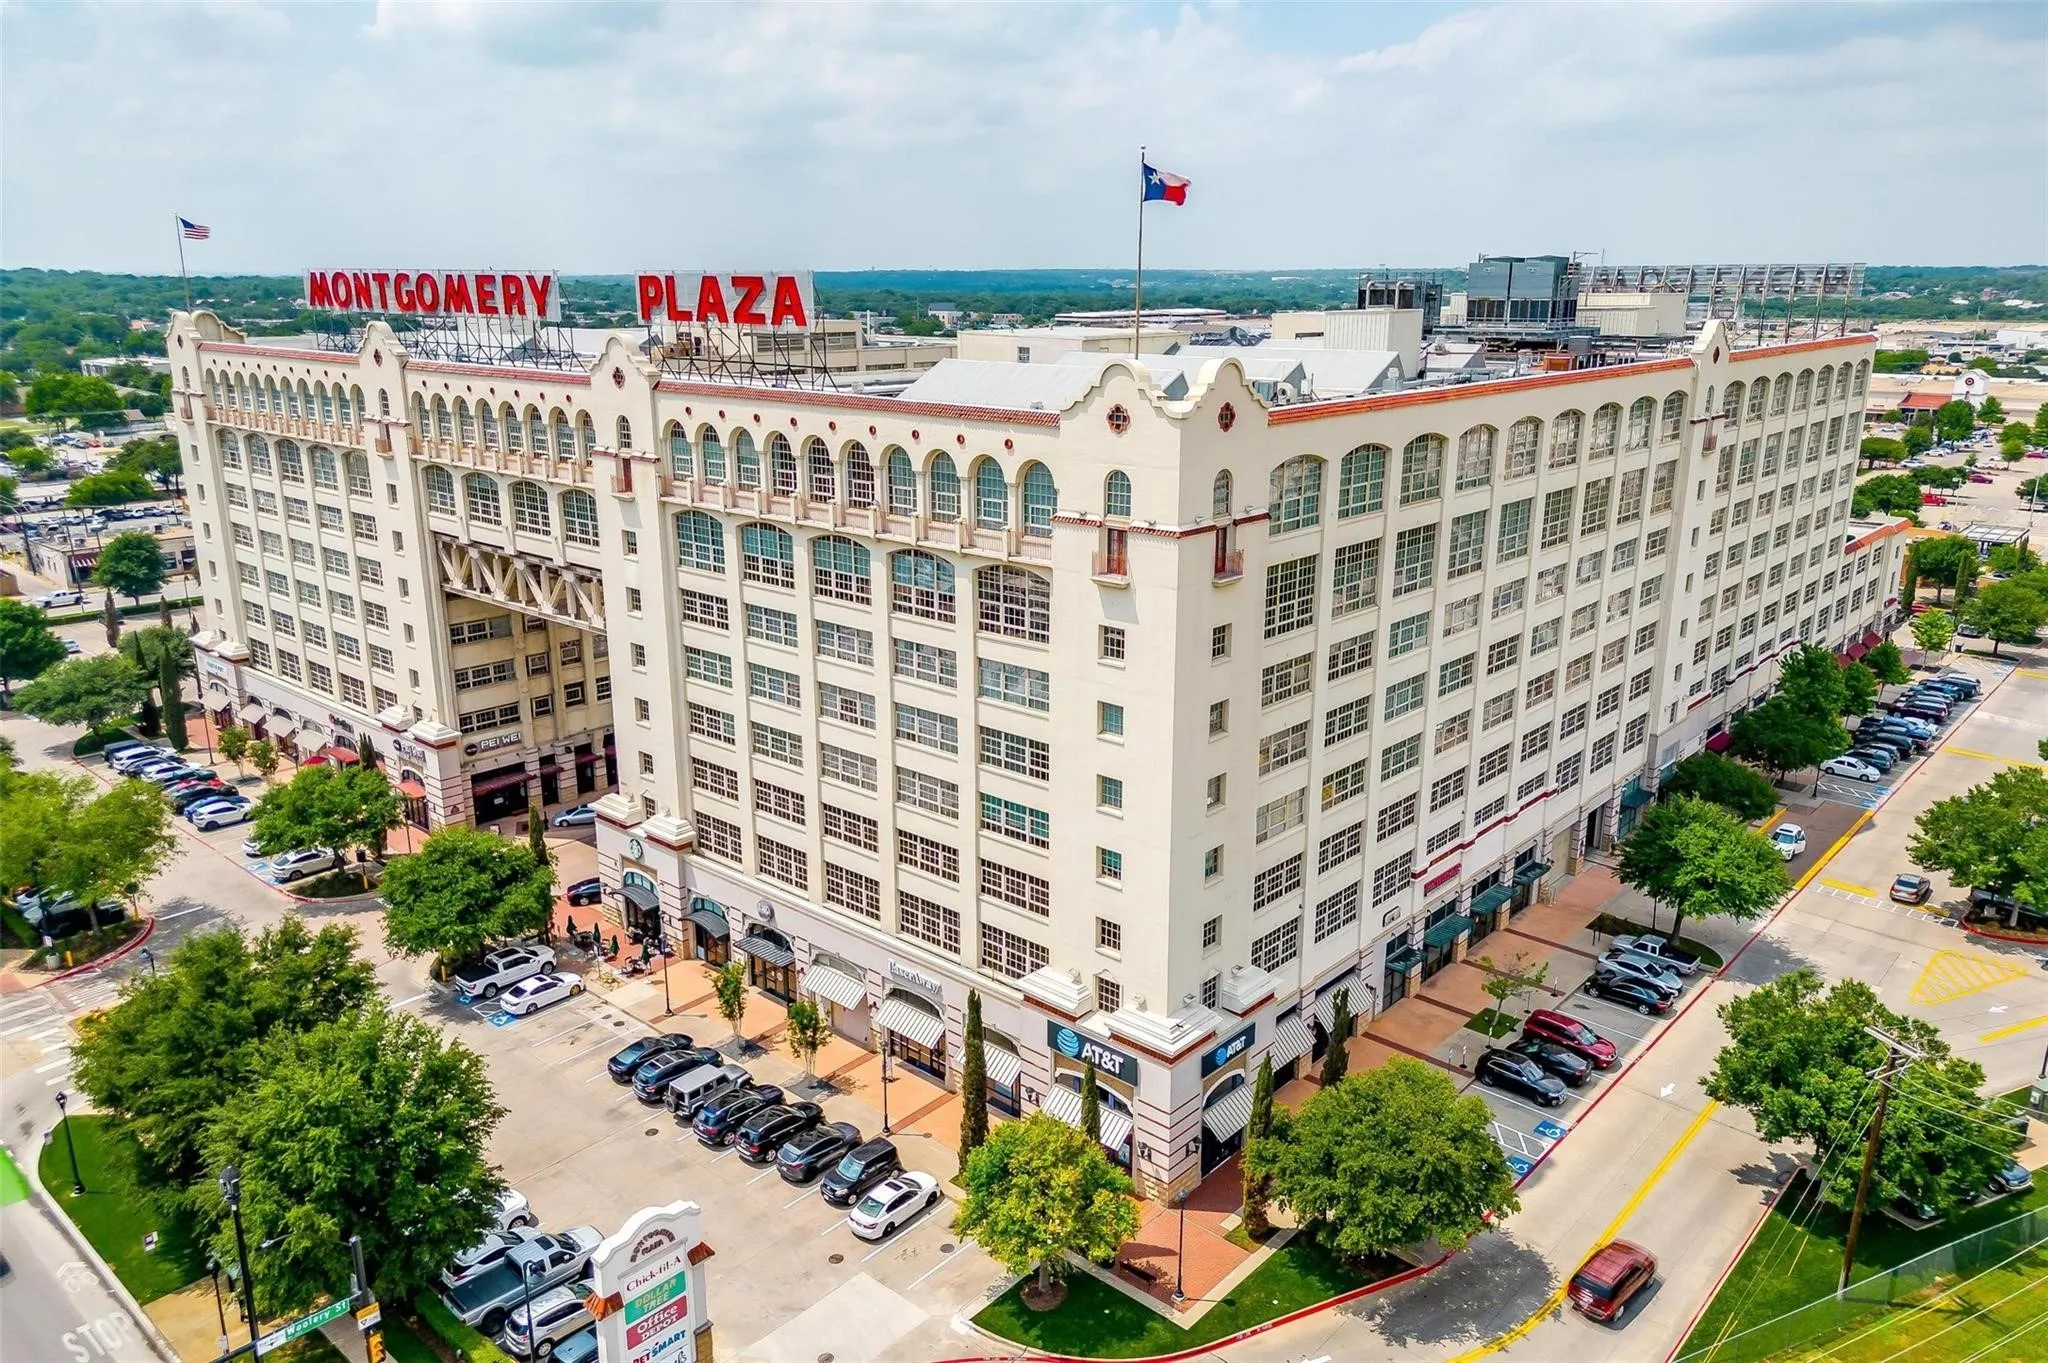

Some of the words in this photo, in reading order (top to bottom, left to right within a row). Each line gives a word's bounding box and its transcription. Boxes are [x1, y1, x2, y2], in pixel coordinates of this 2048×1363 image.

[309, 271, 551, 317] MONTGOMERY
[638, 275, 808, 327] PLAZA
[481, 738, 500, 749] PEI
[502, 732, 521, 744] WEI
[1081, 1042, 1124, 1074] AT&T
[1226, 1036, 1247, 1058] AT&T
[626, 1255, 682, 1292] Chick-fil-A
[635, 1278, 677, 1308] DOLLAR
[644, 1292, 670, 1313] TREE
[286, 1310, 330, 1336] Woolery
[335, 1300, 347, 1313] St
[637, 1304, 678, 1334] Office
[641, 1315, 679, 1342] DEPOT
[62, 1312, 133, 1363] STOP
